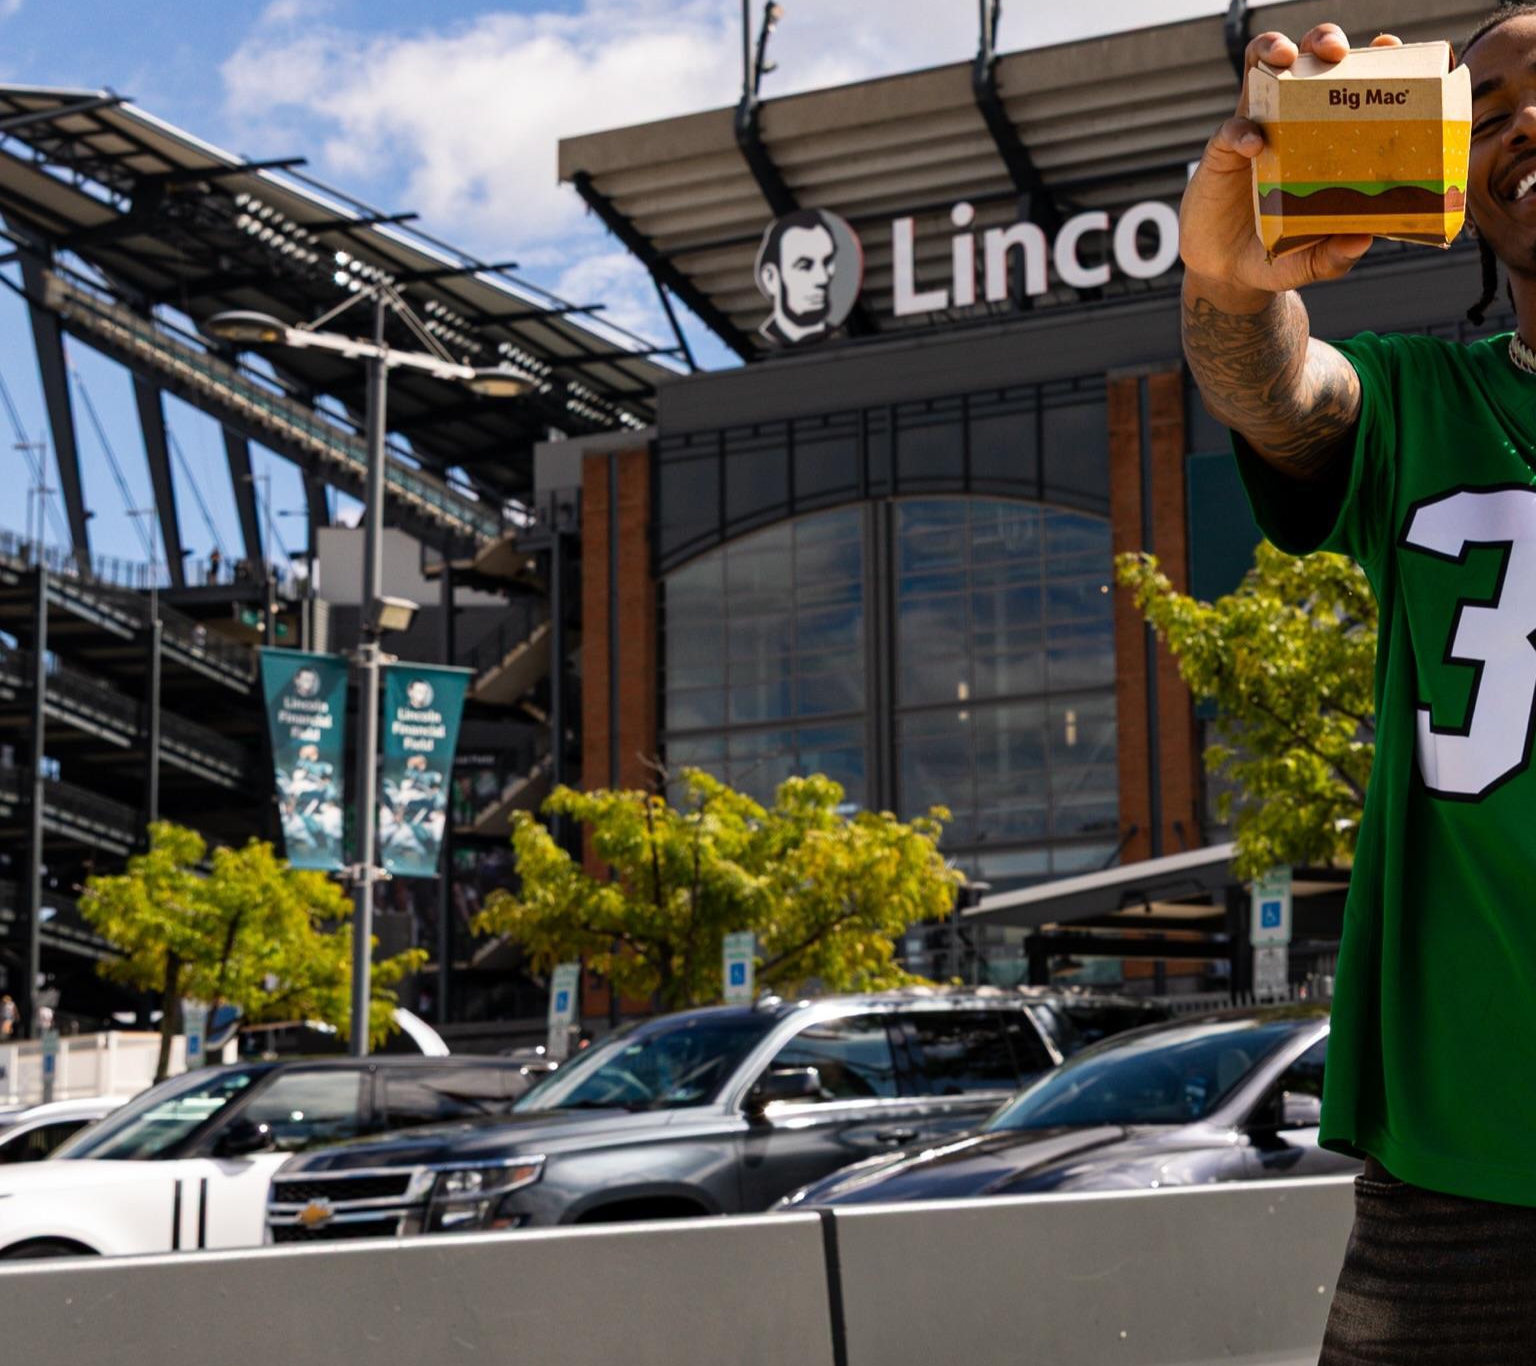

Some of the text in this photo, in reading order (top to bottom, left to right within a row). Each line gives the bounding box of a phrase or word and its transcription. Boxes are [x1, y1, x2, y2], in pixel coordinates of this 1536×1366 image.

[1328, 88, 1407, 110] Big Mac
[892, 161, 1200, 316] Linco
